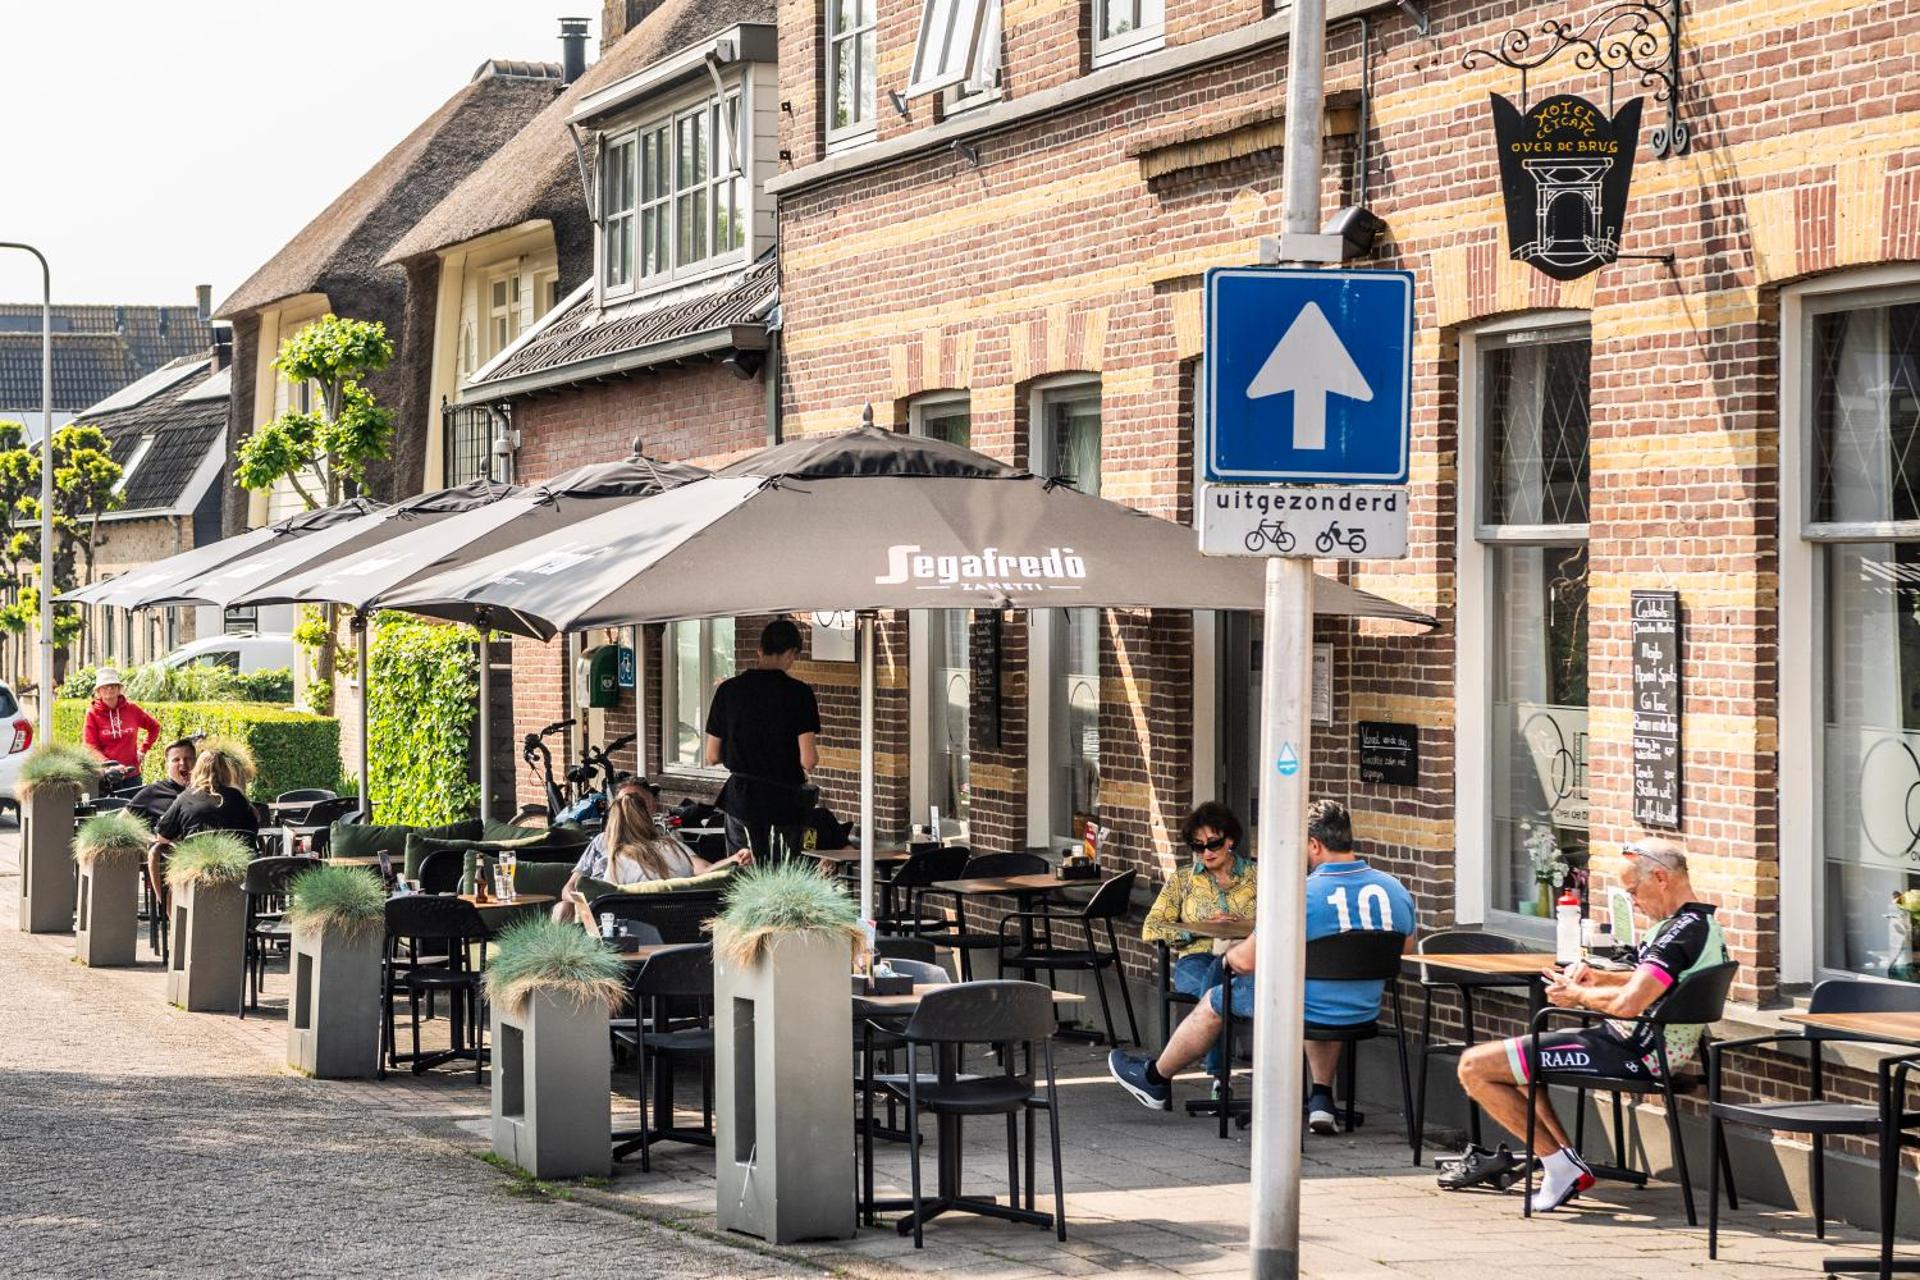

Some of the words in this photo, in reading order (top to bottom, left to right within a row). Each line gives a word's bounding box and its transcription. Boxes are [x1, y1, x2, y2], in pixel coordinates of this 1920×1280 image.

[1533, 101, 1595, 127] HOTEL
[1511, 142, 1552, 152] OVER
[1557, 141, 1574, 152] DE
[1577, 141, 1618, 153] BRUG
[1216, 491, 1396, 515] uitgezonderd
[960, 583, 1043, 591] ZANETTI
[1327, 884, 1393, 932] 10
[1540, 1052, 1590, 1067] RAAD
